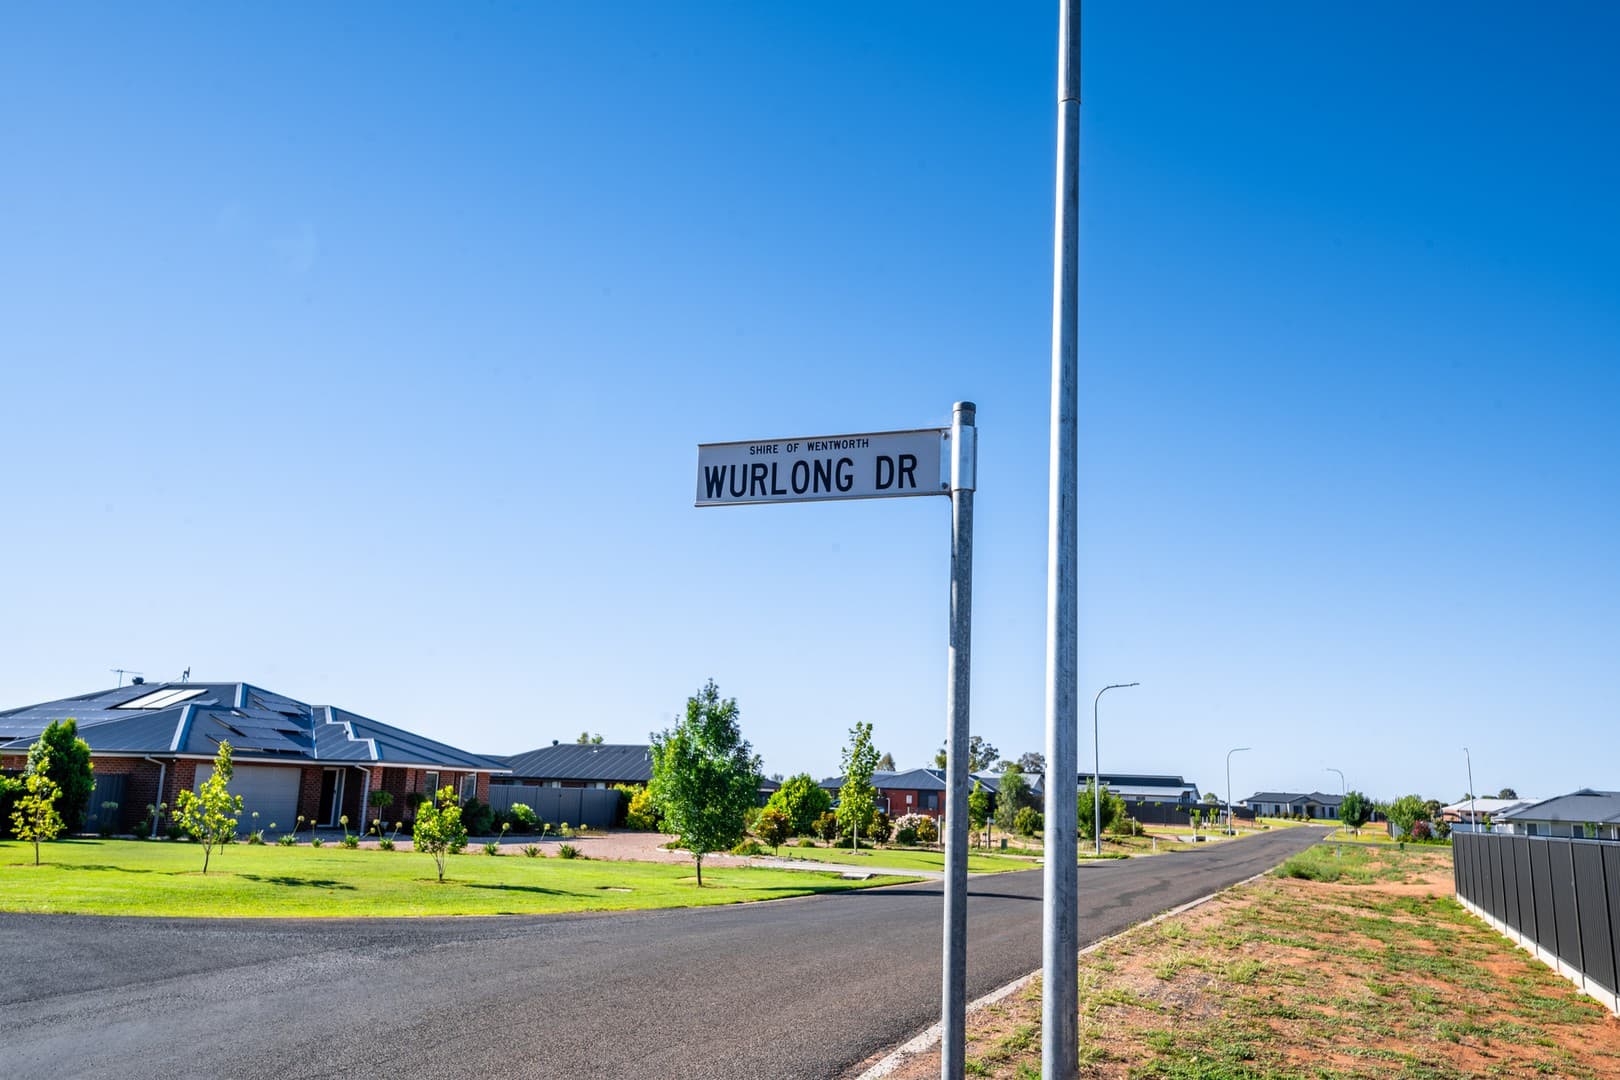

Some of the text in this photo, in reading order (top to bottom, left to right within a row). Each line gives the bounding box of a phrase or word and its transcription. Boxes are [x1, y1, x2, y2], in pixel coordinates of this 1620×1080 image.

[749, 438, 869, 455] SHIRE OF WENTWORTH
[704, 454, 918, 498] WURLONG DR
